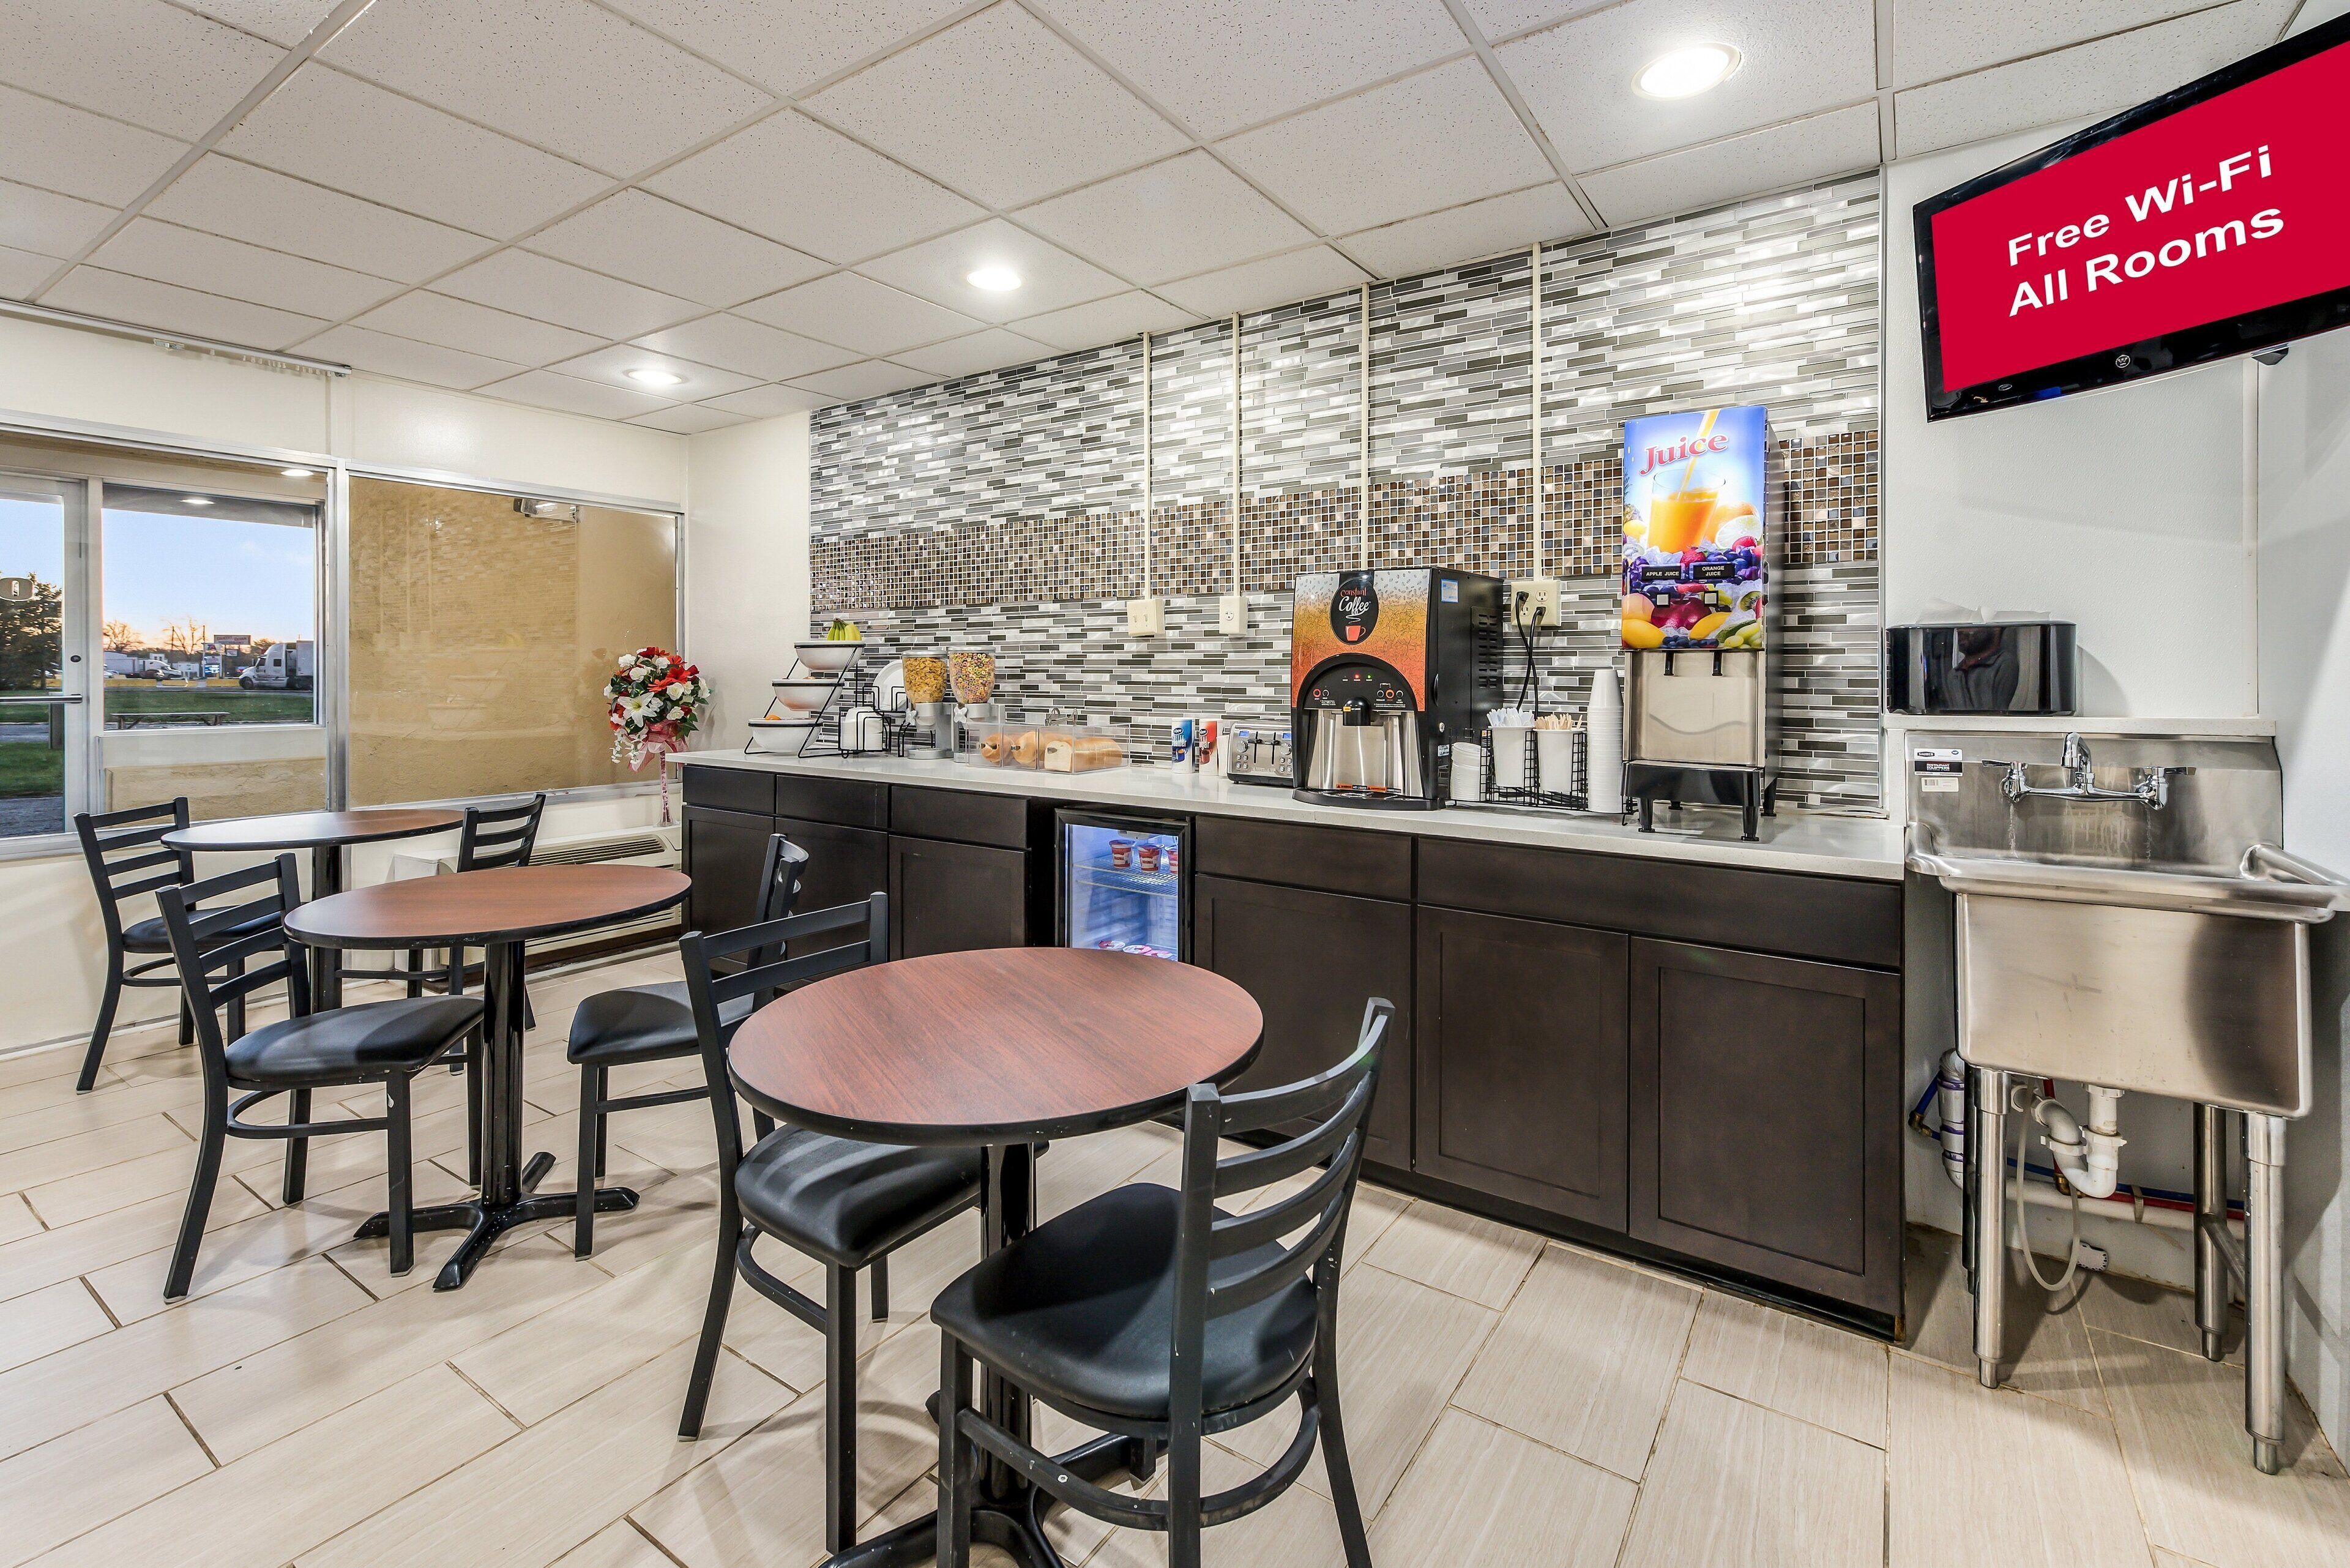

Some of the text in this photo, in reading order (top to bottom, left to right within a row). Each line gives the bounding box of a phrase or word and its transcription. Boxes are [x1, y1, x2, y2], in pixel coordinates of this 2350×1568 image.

[2009, 145, 2272, 266] Free Wi-Fi
[2009, 208, 2284, 317] All Rooms
[1640, 435, 1728, 475] Juice
[1338, 596, 1370, 616] Coffee
